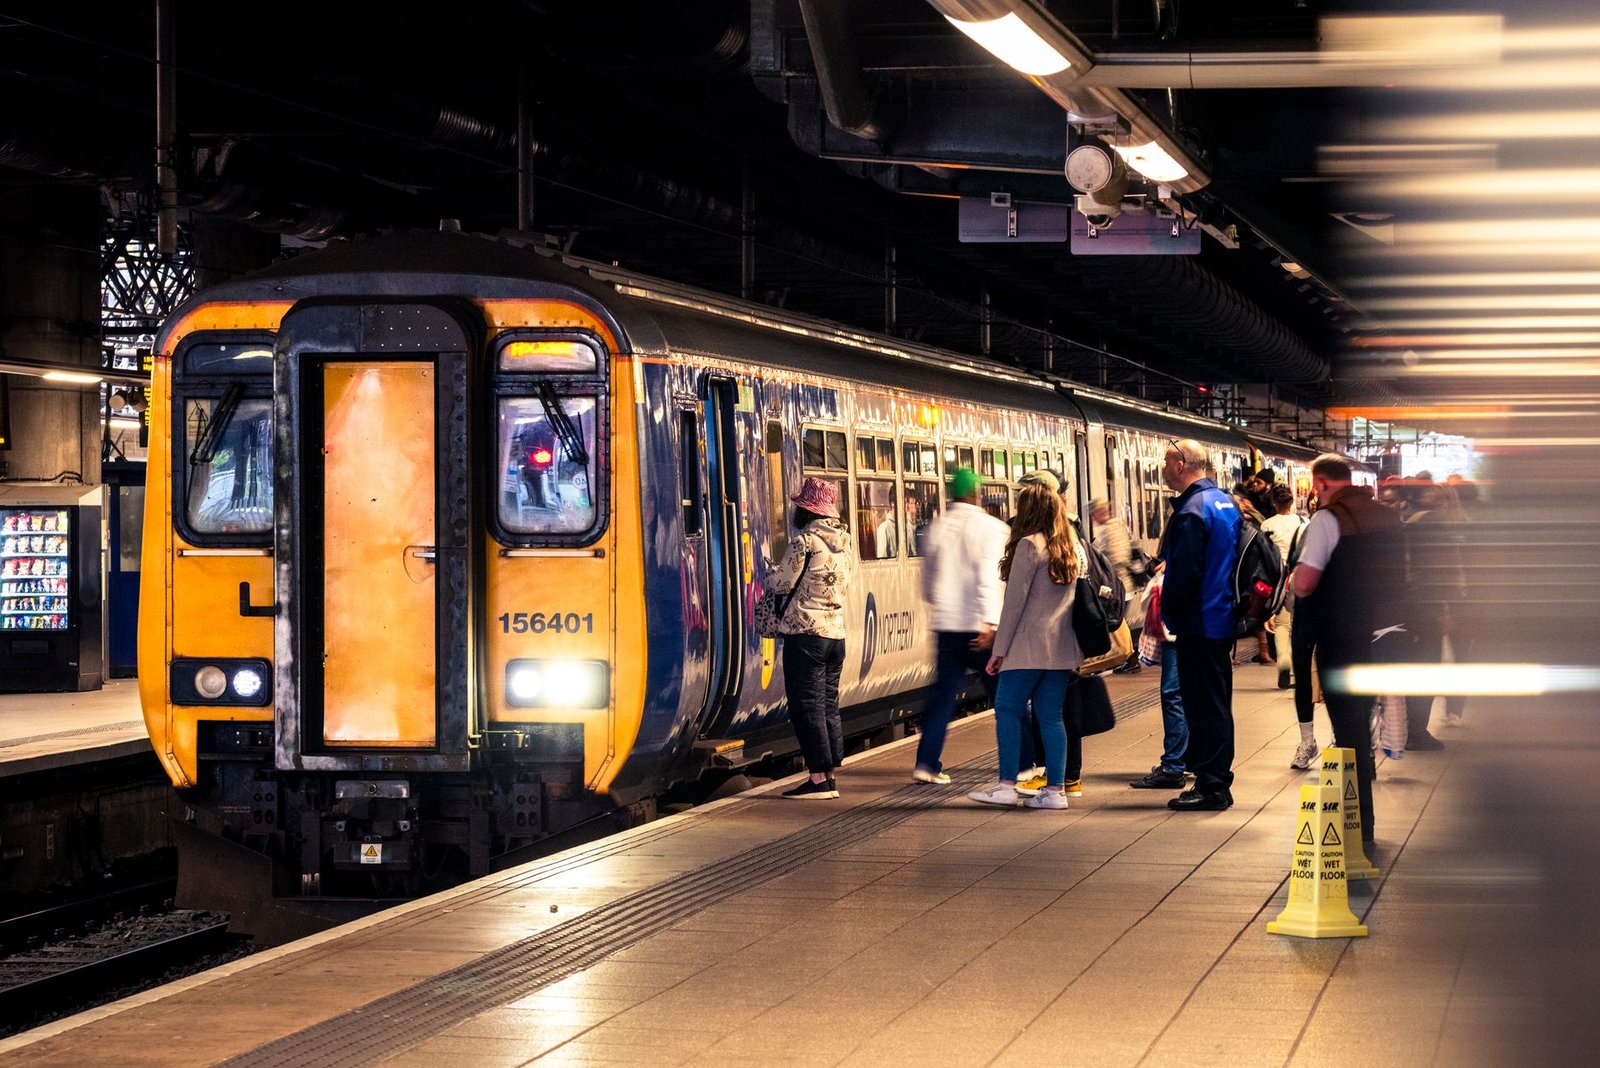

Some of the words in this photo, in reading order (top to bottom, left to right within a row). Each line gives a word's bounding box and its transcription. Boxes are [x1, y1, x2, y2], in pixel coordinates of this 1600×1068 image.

[498, 612, 593, 634] 156401
[877, 611, 914, 655] NORTHERN
[1301, 801, 1316, 810] SIR
[1322, 802, 1339, 811] SIR
[1344, 822, 1360, 830] FLOOR
[1297, 859, 1311, 868] WET
[1324, 860, 1340, 869] WET
[1292, 870, 1314, 879] FLOOR
[1320, 871, 1346, 880] FLOOR
